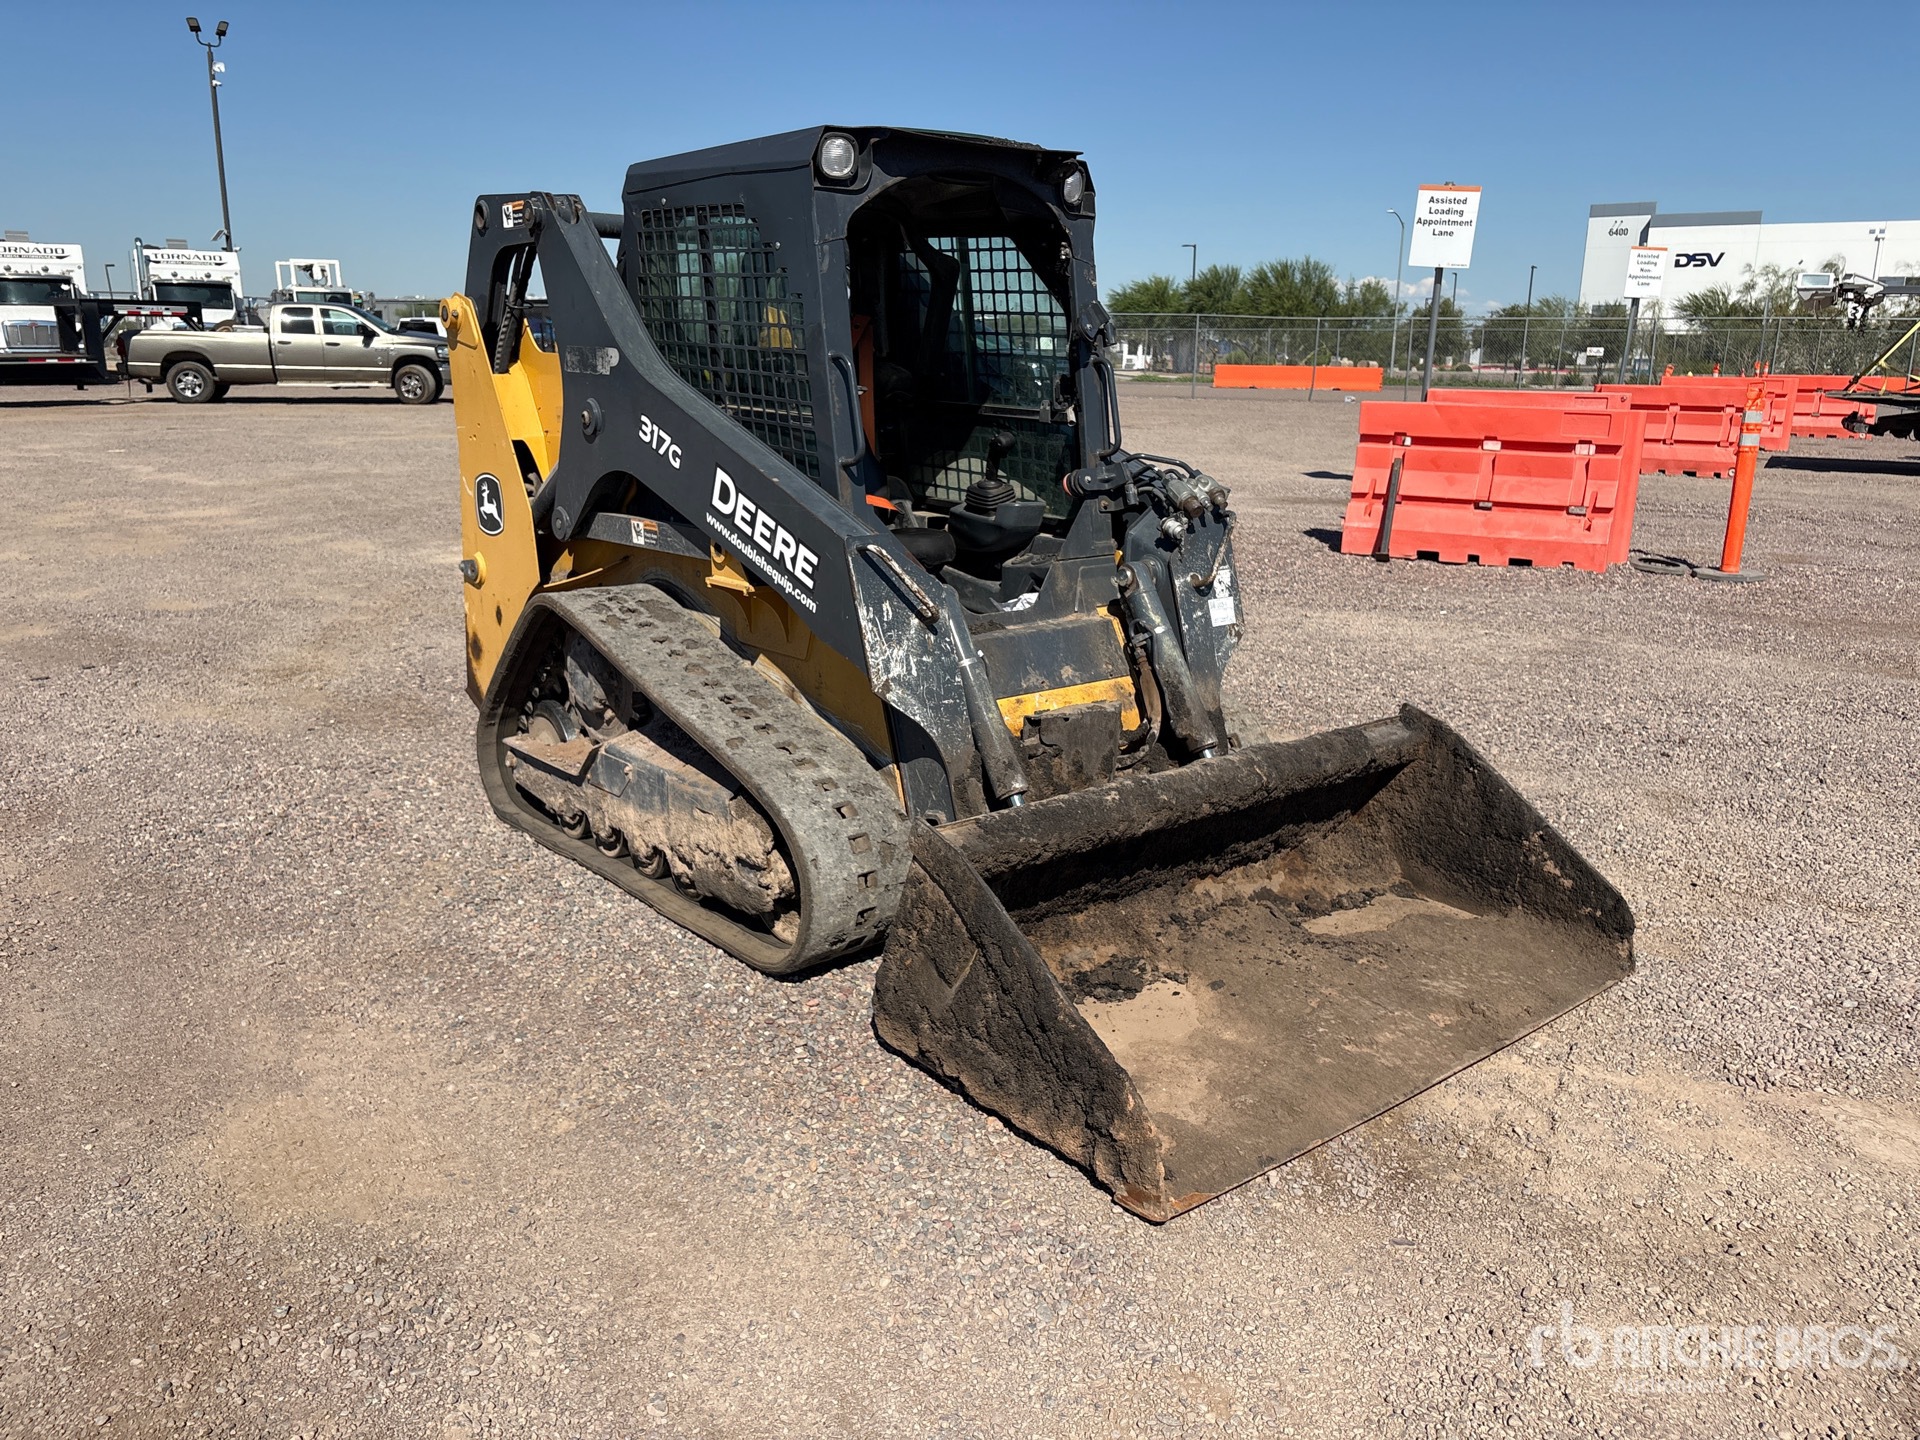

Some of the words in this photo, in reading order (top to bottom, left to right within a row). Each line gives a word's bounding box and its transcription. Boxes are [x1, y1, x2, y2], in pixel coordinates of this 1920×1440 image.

[1428, 196, 1468, 205] Assisted
[1428, 207, 1464, 217] Loading
[1416, 217, 1473, 227] Appointment
[1432, 228, 1454, 237] Lane
[1608, 228, 1629, 237] 6400
[0, 246, 65, 254] ORNADO
[152, 253, 223, 261] TORNADO
[1674, 252, 1725, 268] DSV
[638, 415, 682, 470] 317G
[711, 467, 819, 590] DEERE
[706, 512, 817, 614] www.doublehequip.com
